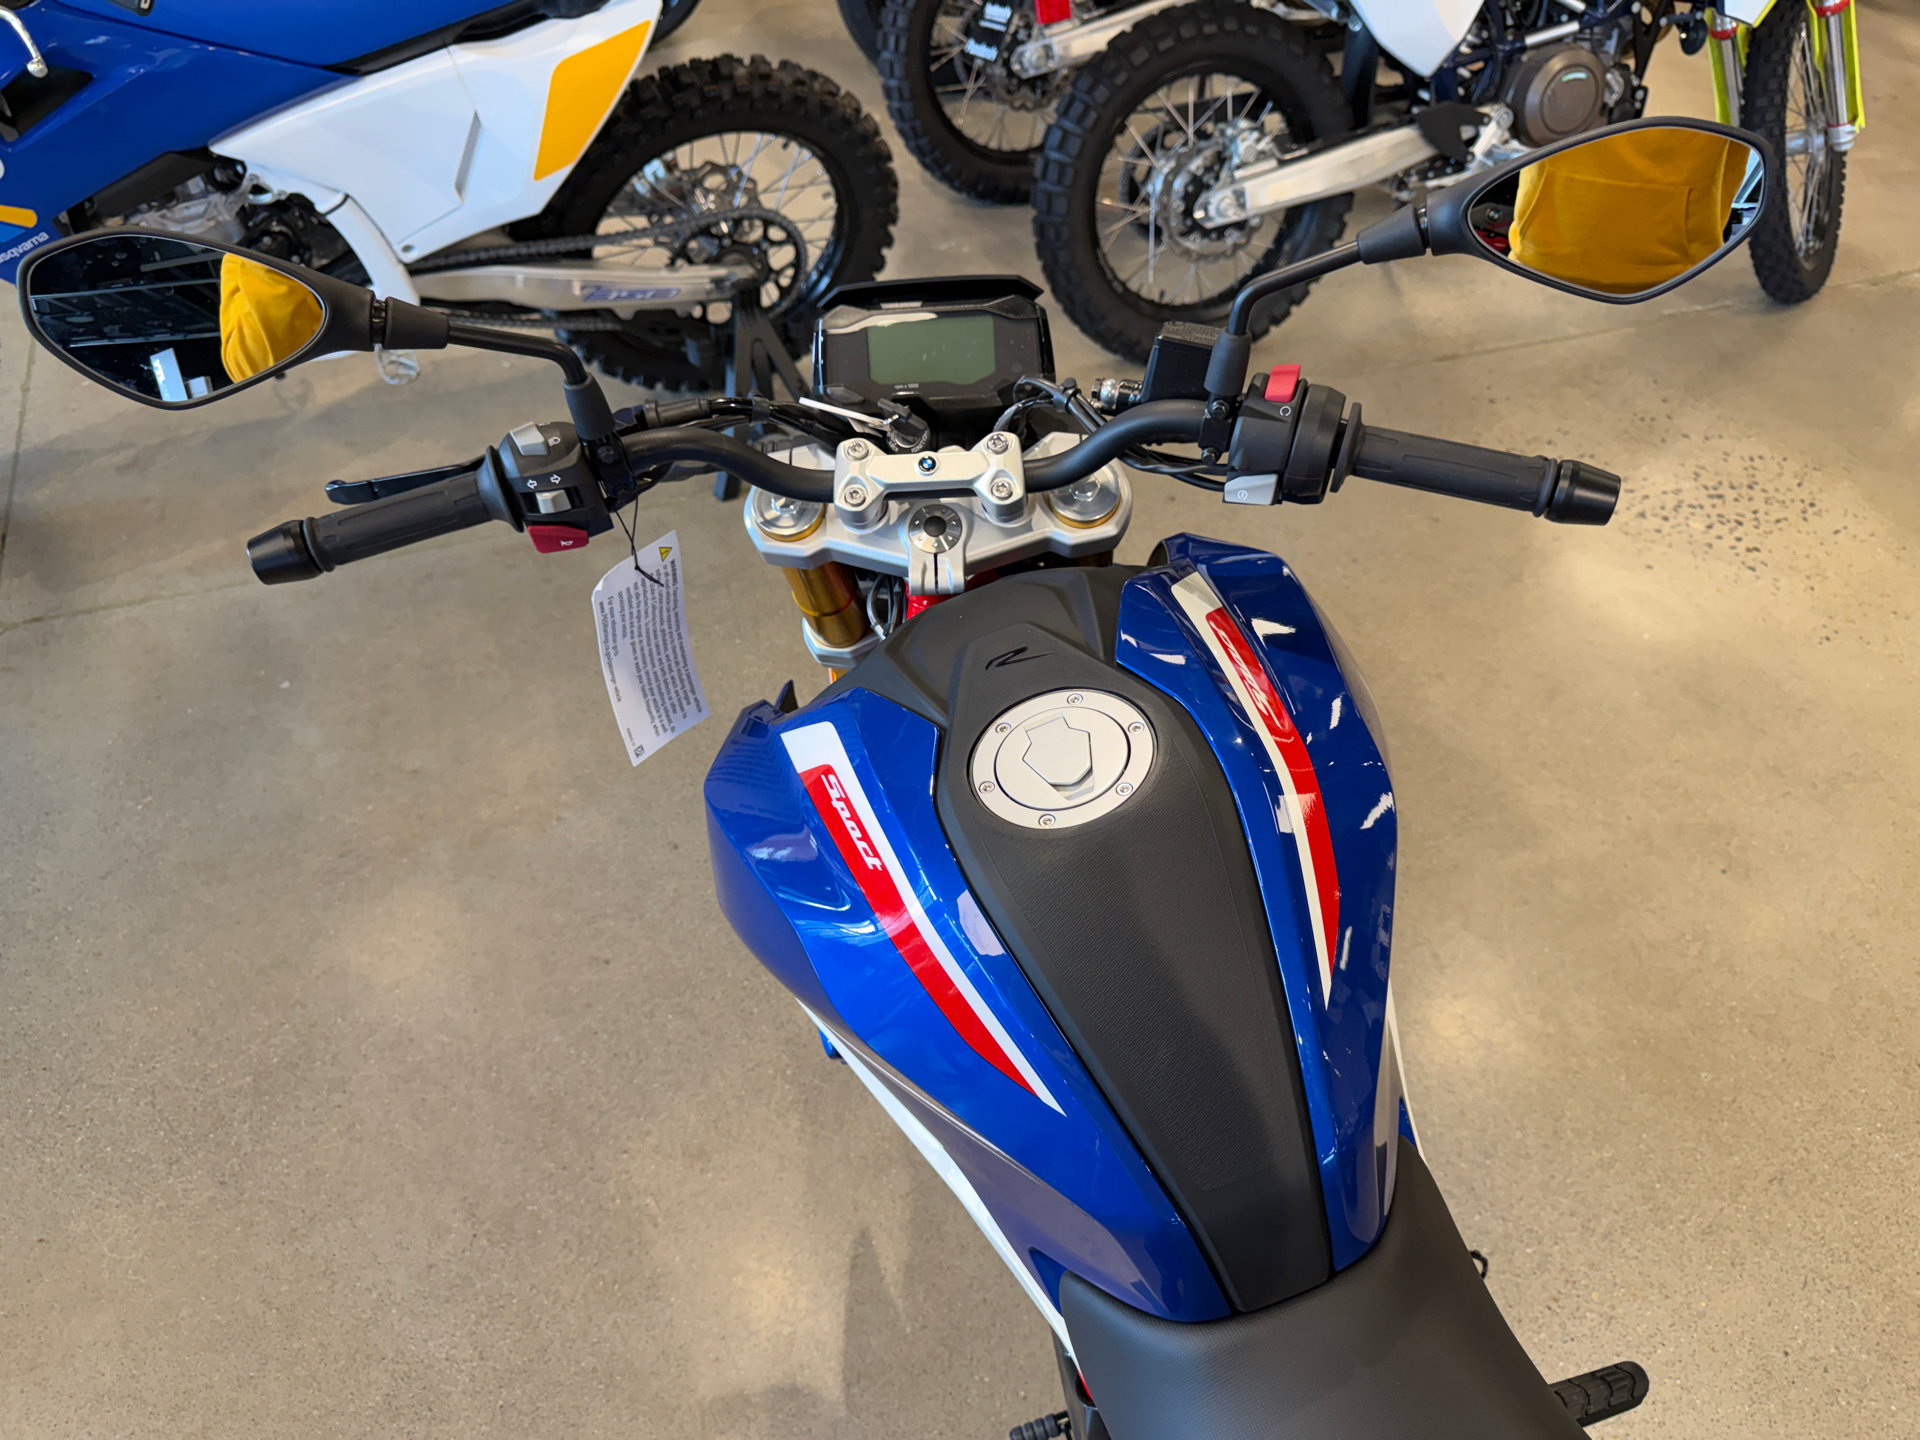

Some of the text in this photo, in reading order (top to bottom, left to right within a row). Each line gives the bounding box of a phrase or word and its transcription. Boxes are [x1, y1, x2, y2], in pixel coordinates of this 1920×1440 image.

[0, 232, 50, 264] sqvarna
[682, 689, 691, 706] engine
[685, 671, 696, 695] passenger
[693, 696, 703, 713] vehicle
[652, 697, 661, 714] vehicle
